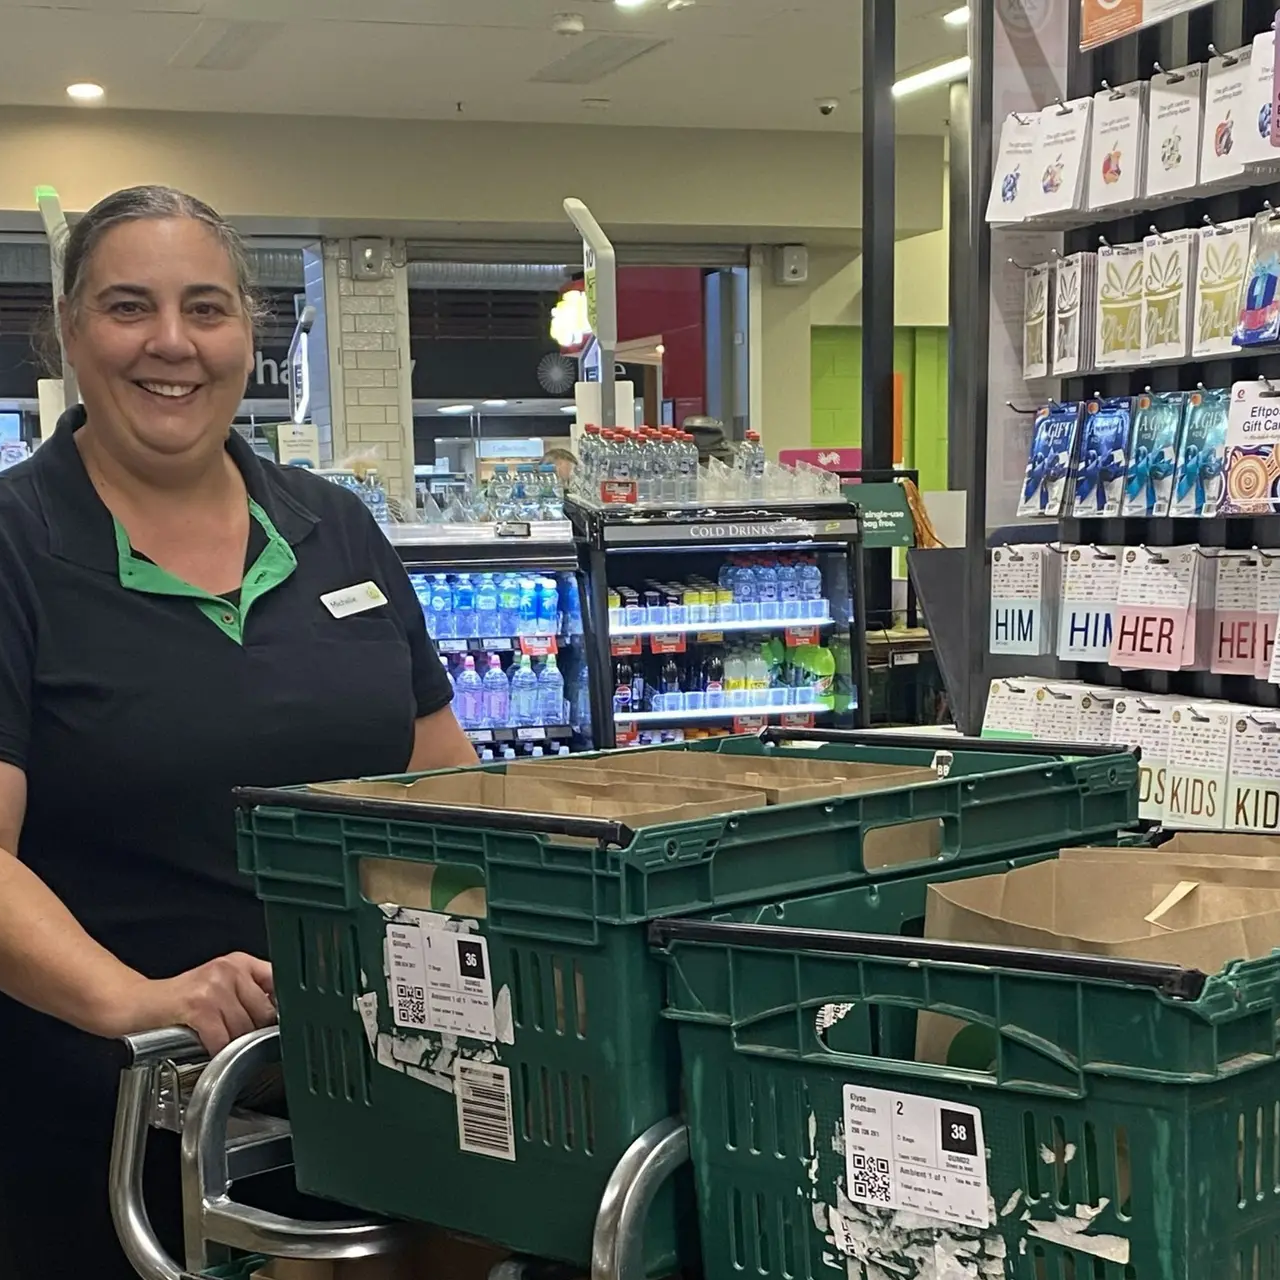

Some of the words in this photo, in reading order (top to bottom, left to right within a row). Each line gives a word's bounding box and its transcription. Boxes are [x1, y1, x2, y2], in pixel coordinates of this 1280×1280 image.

[1242, 420, 1263, 433] Gift
[690, 525, 725, 537] COLD
[728, 524, 776, 536] DRINKS
[864, 510, 904, 519] single-use
[995, 608, 1034, 642] HIM
[1118, 614, 1175, 654] HER
[1218, 621, 1257, 660] HE
[1139, 767, 1167, 804] DS
[1169, 776, 1217, 818] KIDS
[1235, 787, 1280, 829] KID
[426, 936, 432, 949] 1
[465, 953, 477, 967] 36
[896, 1100, 904, 1116] 2
[950, 1123, 967, 1141] 38
